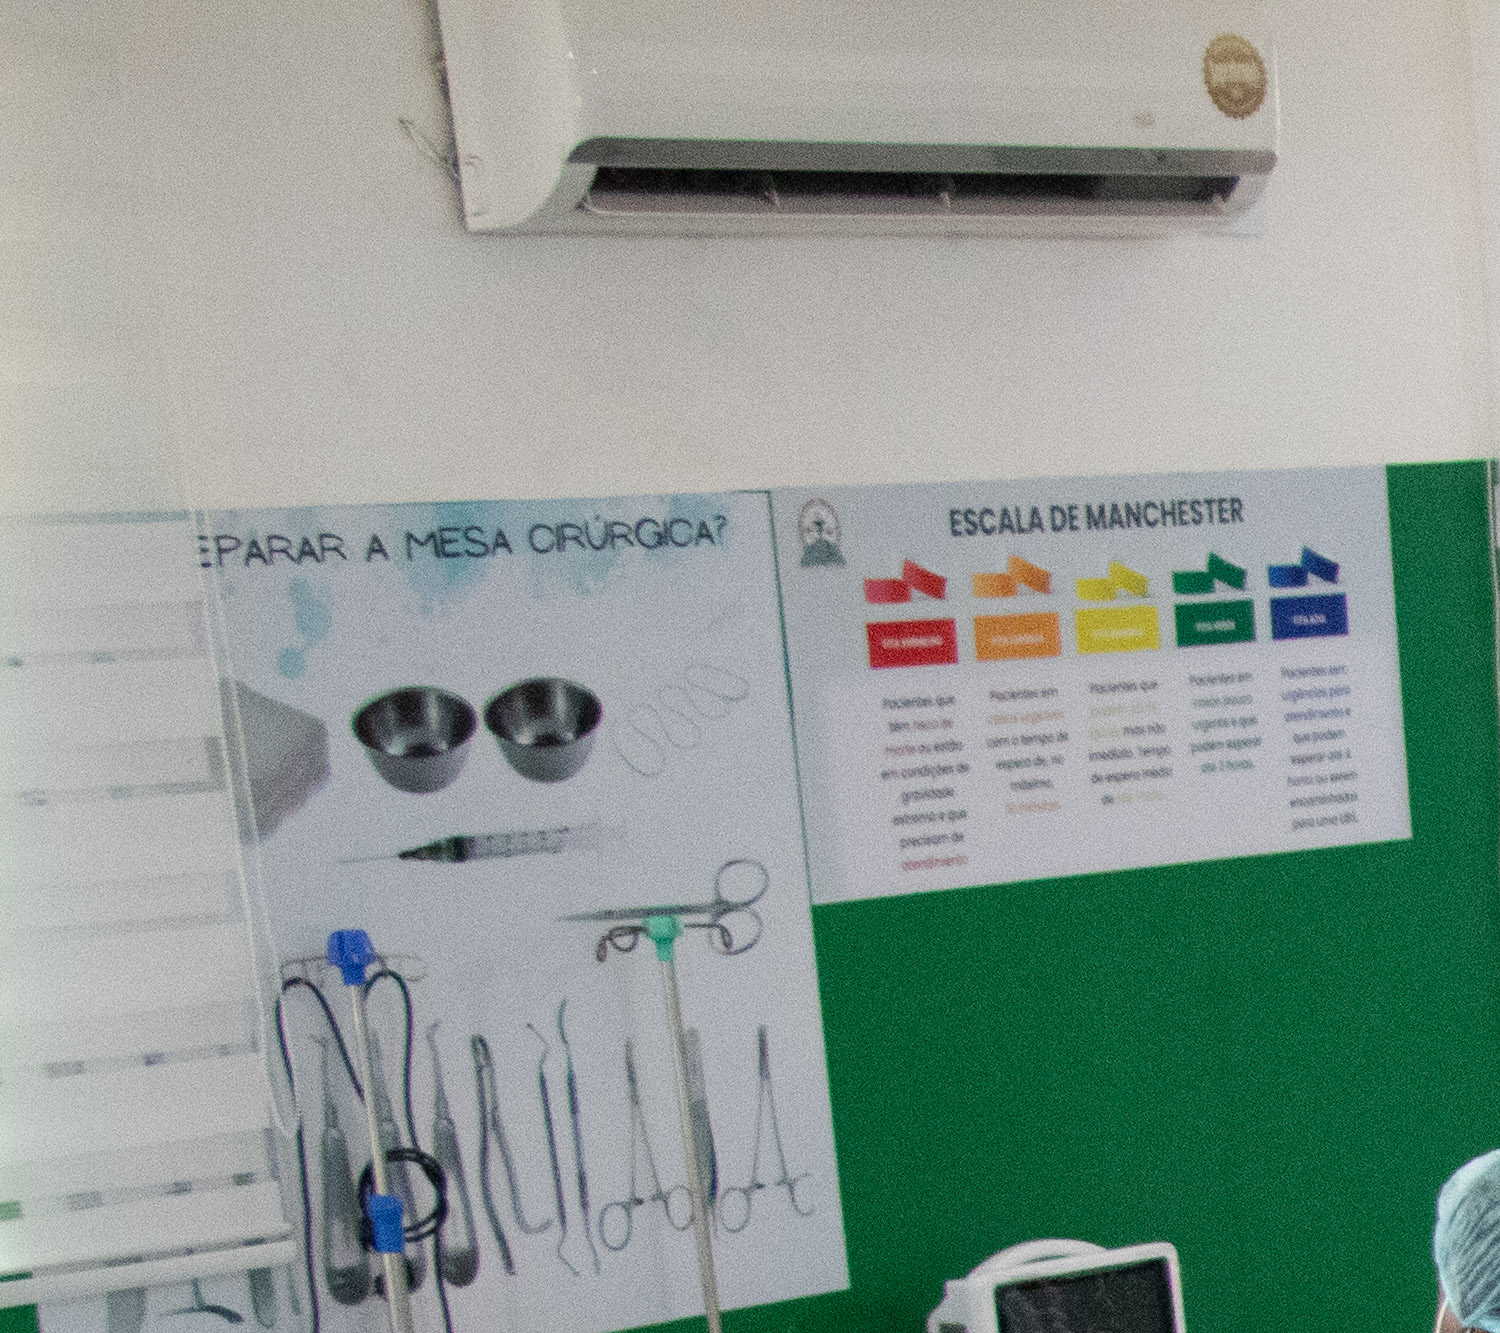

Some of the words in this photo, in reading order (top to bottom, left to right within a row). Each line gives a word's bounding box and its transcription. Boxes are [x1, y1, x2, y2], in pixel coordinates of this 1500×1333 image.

[366, 533, 389, 562] A
[404, 525, 512, 563] MESA
[528, 514, 728, 554] CIRÚRGICA?
[949, 503, 1044, 537] ESCALA
[1047, 501, 1079, 533] DE
[1084, 496, 1245, 530] MANCHESTER
